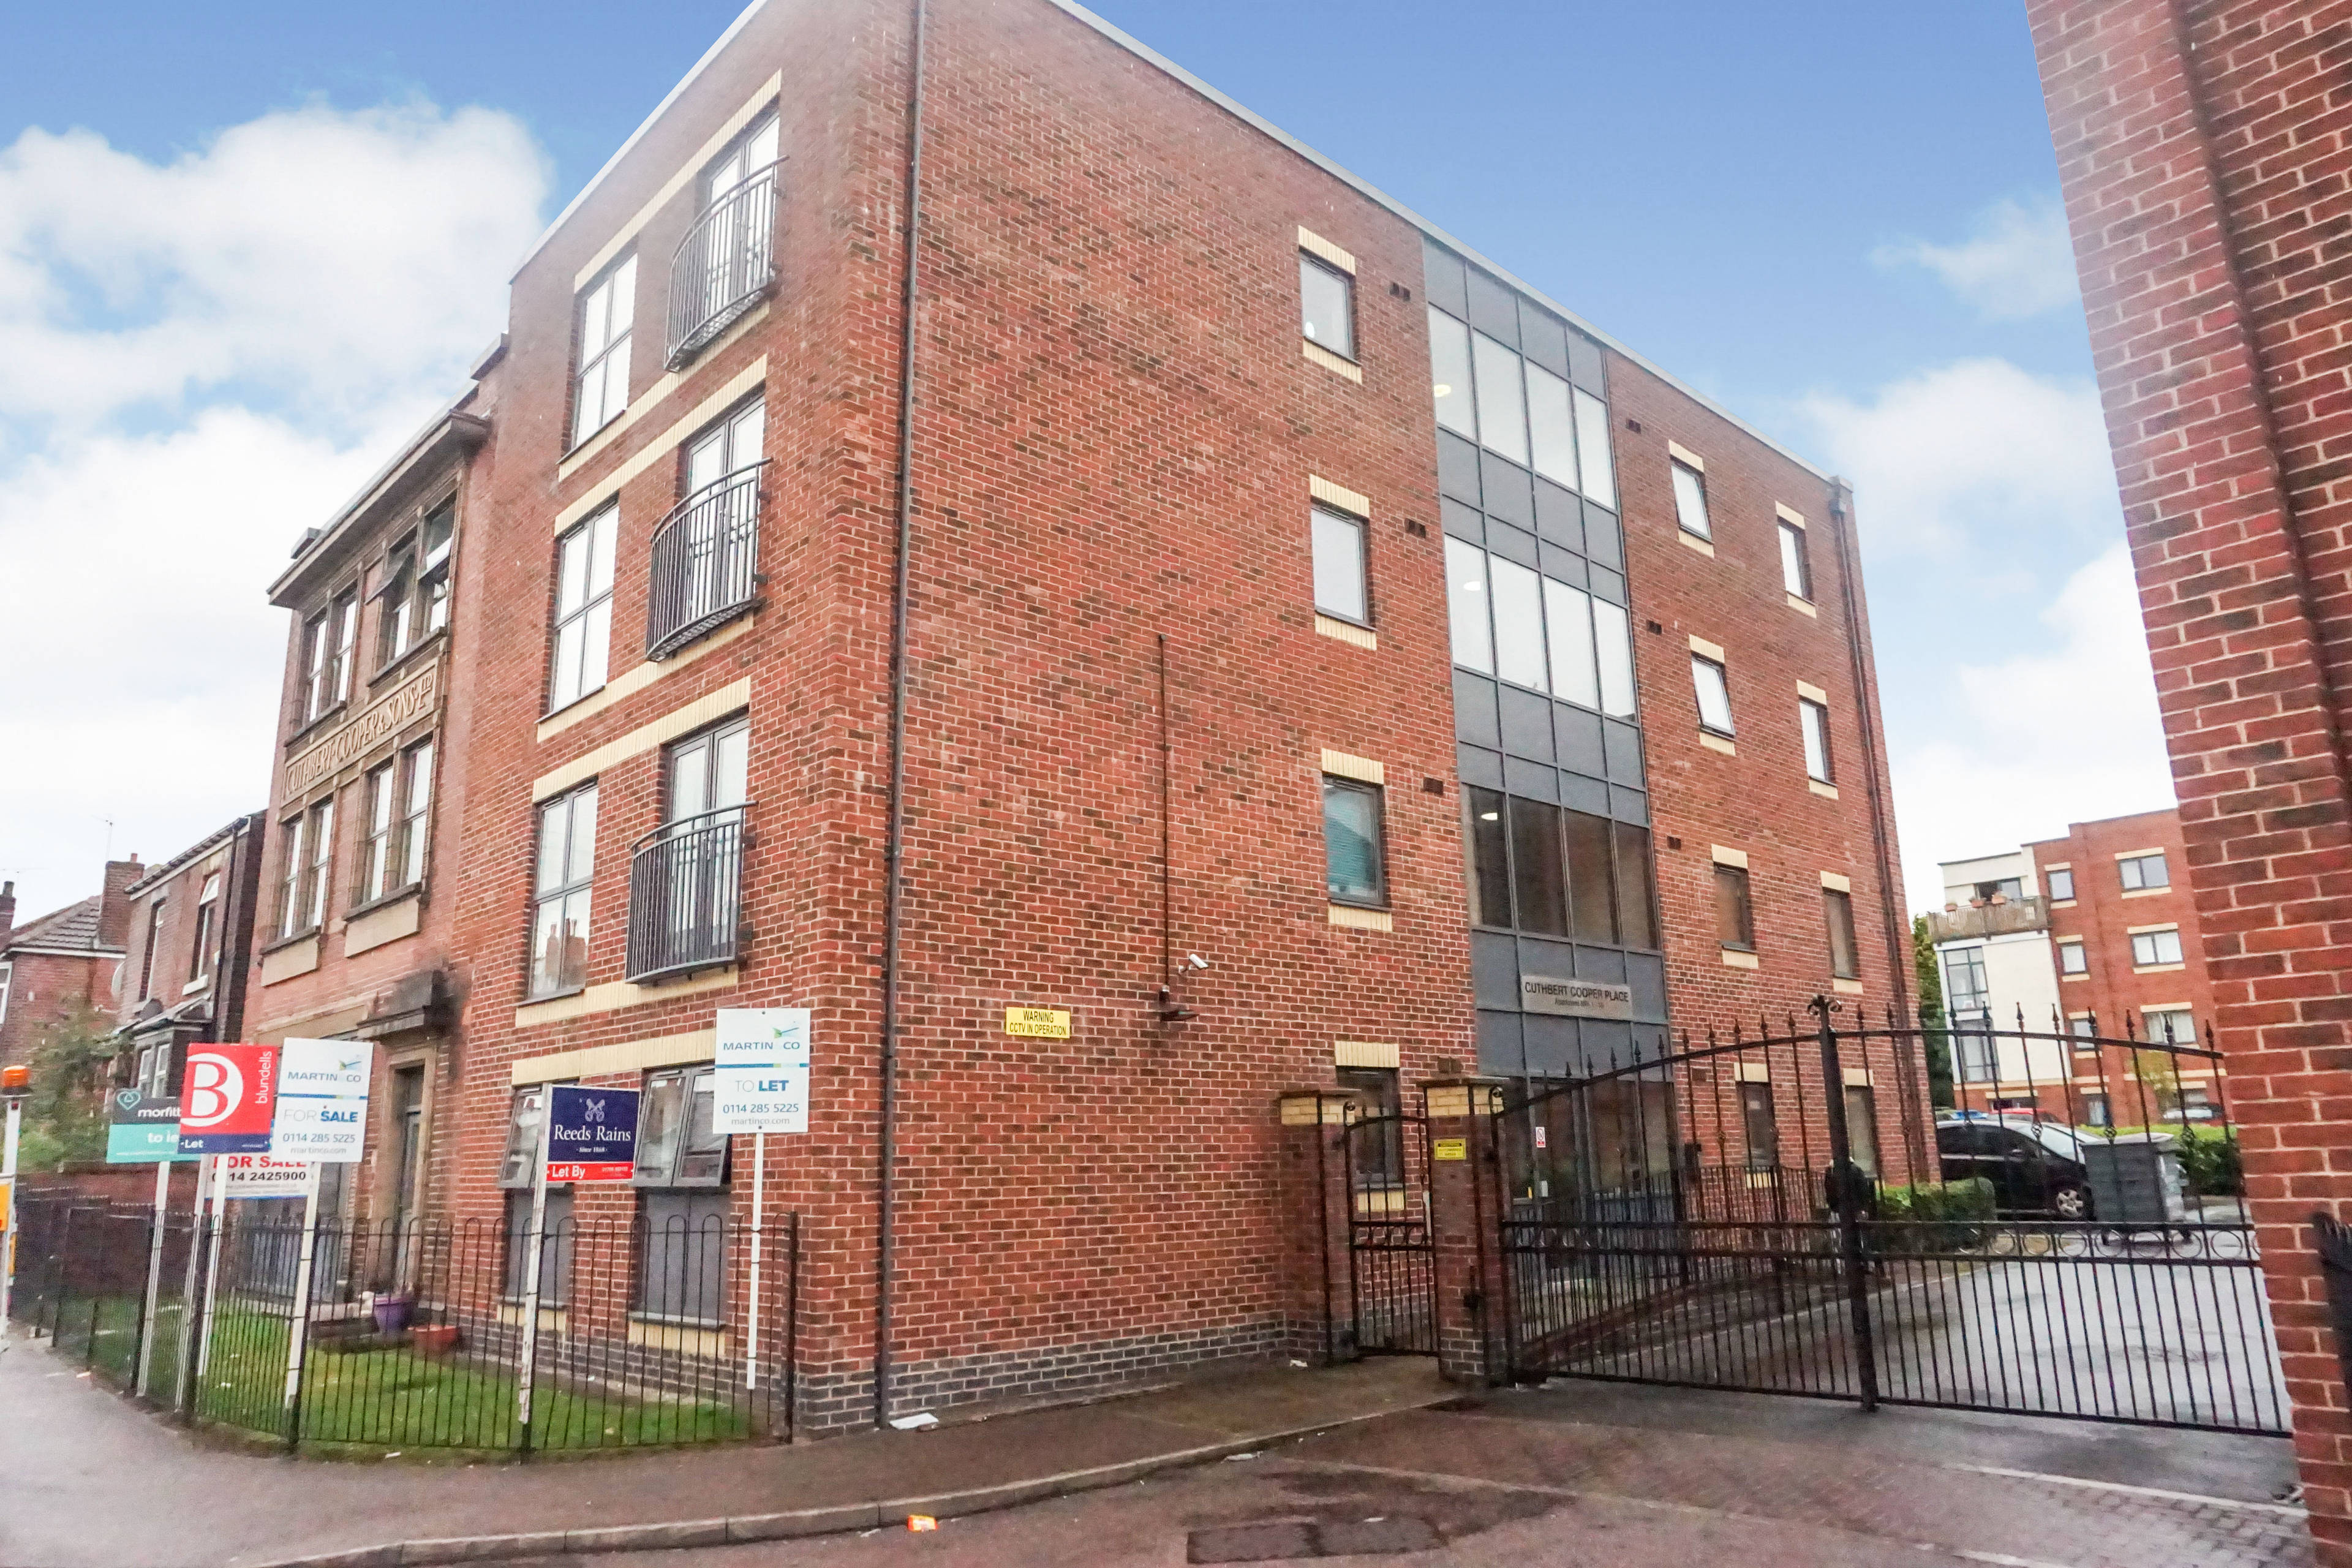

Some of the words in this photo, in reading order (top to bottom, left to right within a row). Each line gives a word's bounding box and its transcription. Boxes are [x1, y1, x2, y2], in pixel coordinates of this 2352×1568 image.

[1525, 982, 1568, 995] CUTHBERT
[1570, 987, 1603, 1000] COOPER
[1604, 990, 1629, 1003] PLACE
[1023, 1011, 1054, 1023] WARNING
[1009, 1022, 1025, 1033] CCTV
[1027, 1023, 1033, 1034] IN
[1035, 1024, 1066, 1035] OPERATION
[723, 1042, 773, 1050] MARTIN
[783, 1041, 800, 1050] CO
[255, 1051, 272, 1104] blundells
[288, 1071, 337, 1081] MARTIN
[346, 1074, 361, 1083] CO
[735, 1080, 755, 1092] TO
[758, 1080, 789, 1091] LET
[723, 1104, 747, 1114] 0114
[750, 1104, 769, 1113] 285
[774, 1103, 799, 1113] 5225
[284, 1109, 317, 1122] FOR
[320, 1110, 358, 1123] SALE
[731, 1117, 790, 1125] martinco.com
[148, 1132, 163, 1143] to
[283, 1133, 307, 1142] 0114
[311, 1134, 330, 1143] 285
[333, 1134, 355, 1143] 5225
[554, 1125, 591, 1140] Reeds
[596, 1126, 631, 1141] Rains
[184, 1139, 204, 1148] Let
[249, 1171, 306, 1181] 2425900
[552, 1166, 569, 1177] Let
[572, 1165, 586, 1179] By
